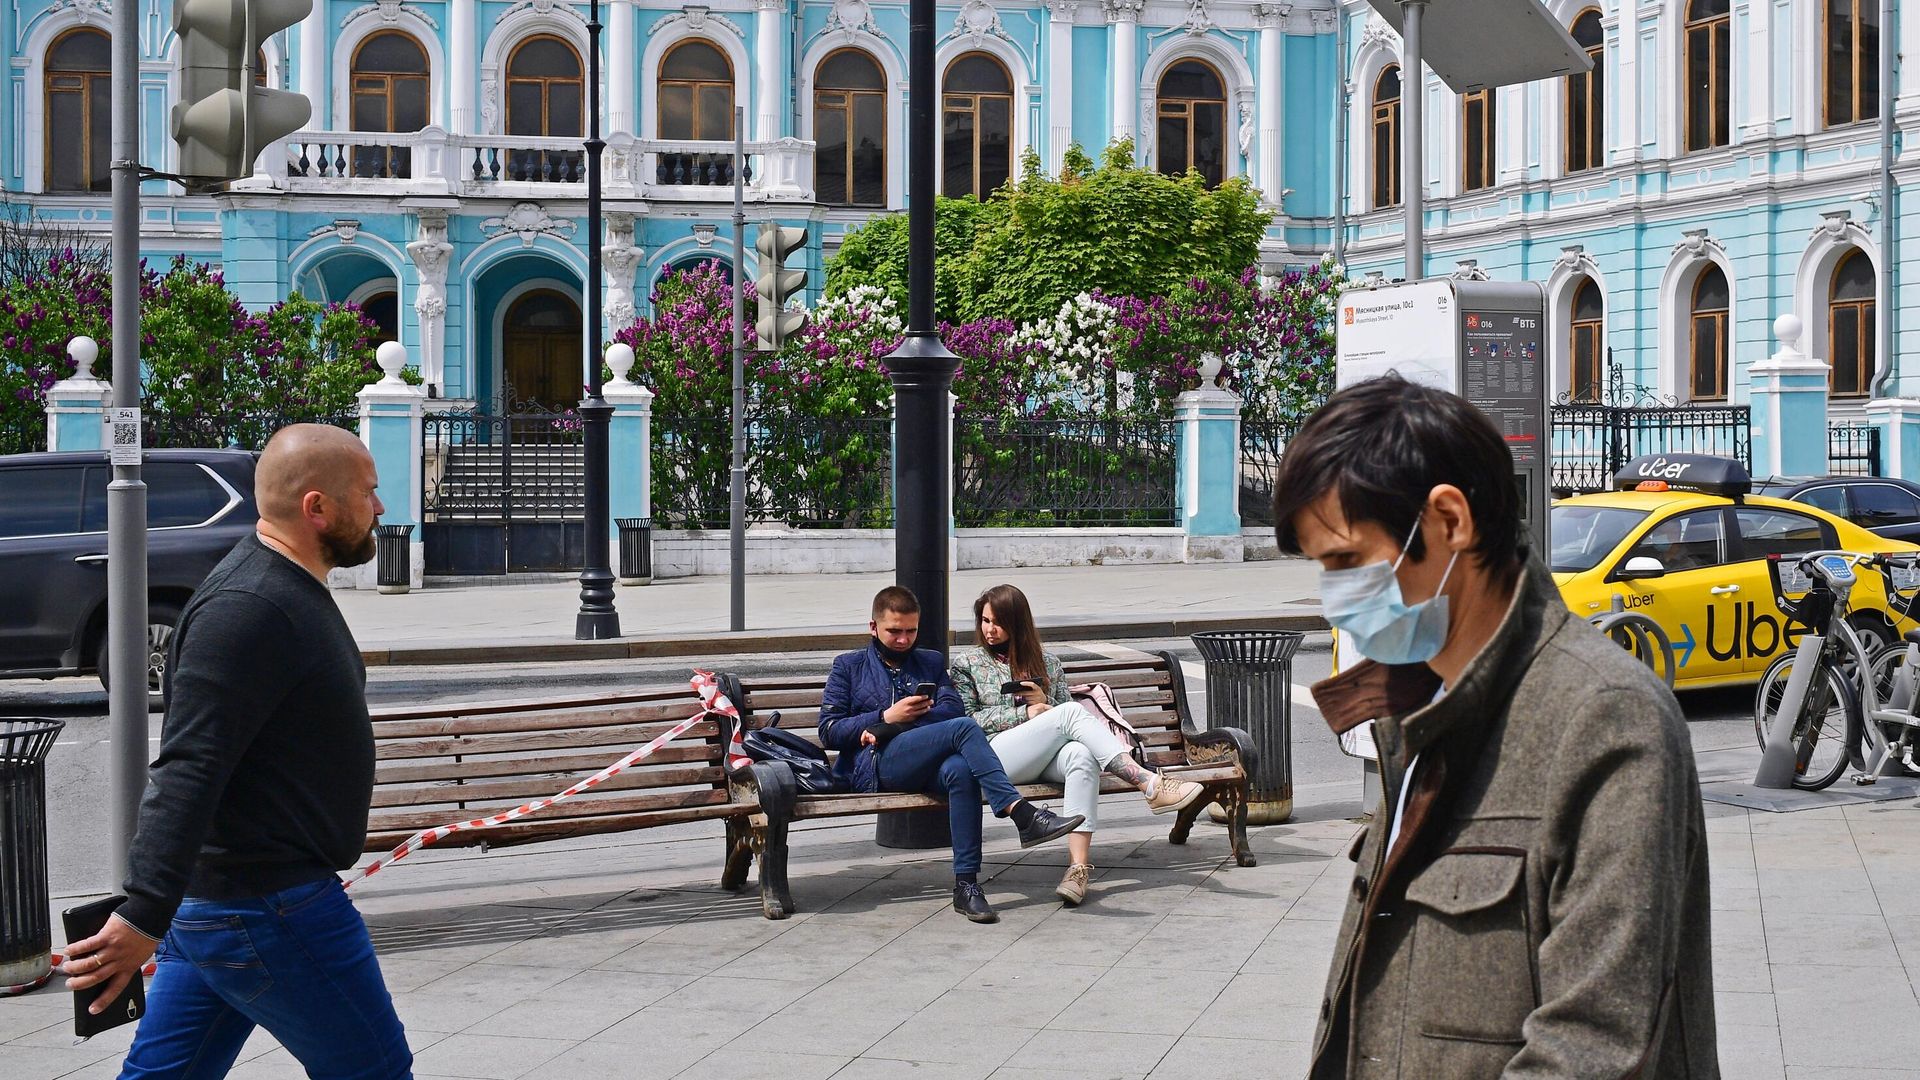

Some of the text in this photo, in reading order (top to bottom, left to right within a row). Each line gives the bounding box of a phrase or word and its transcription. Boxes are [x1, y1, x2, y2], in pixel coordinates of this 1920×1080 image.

[1355, 305, 1384, 315] Мясницкая
[1384, 303, 1402, 313] улица,
[1481, 320, 1493, 328] 016
[1520, 319, 1536, 329] ВТБ
[1706, 601, 1816, 662] Ube
